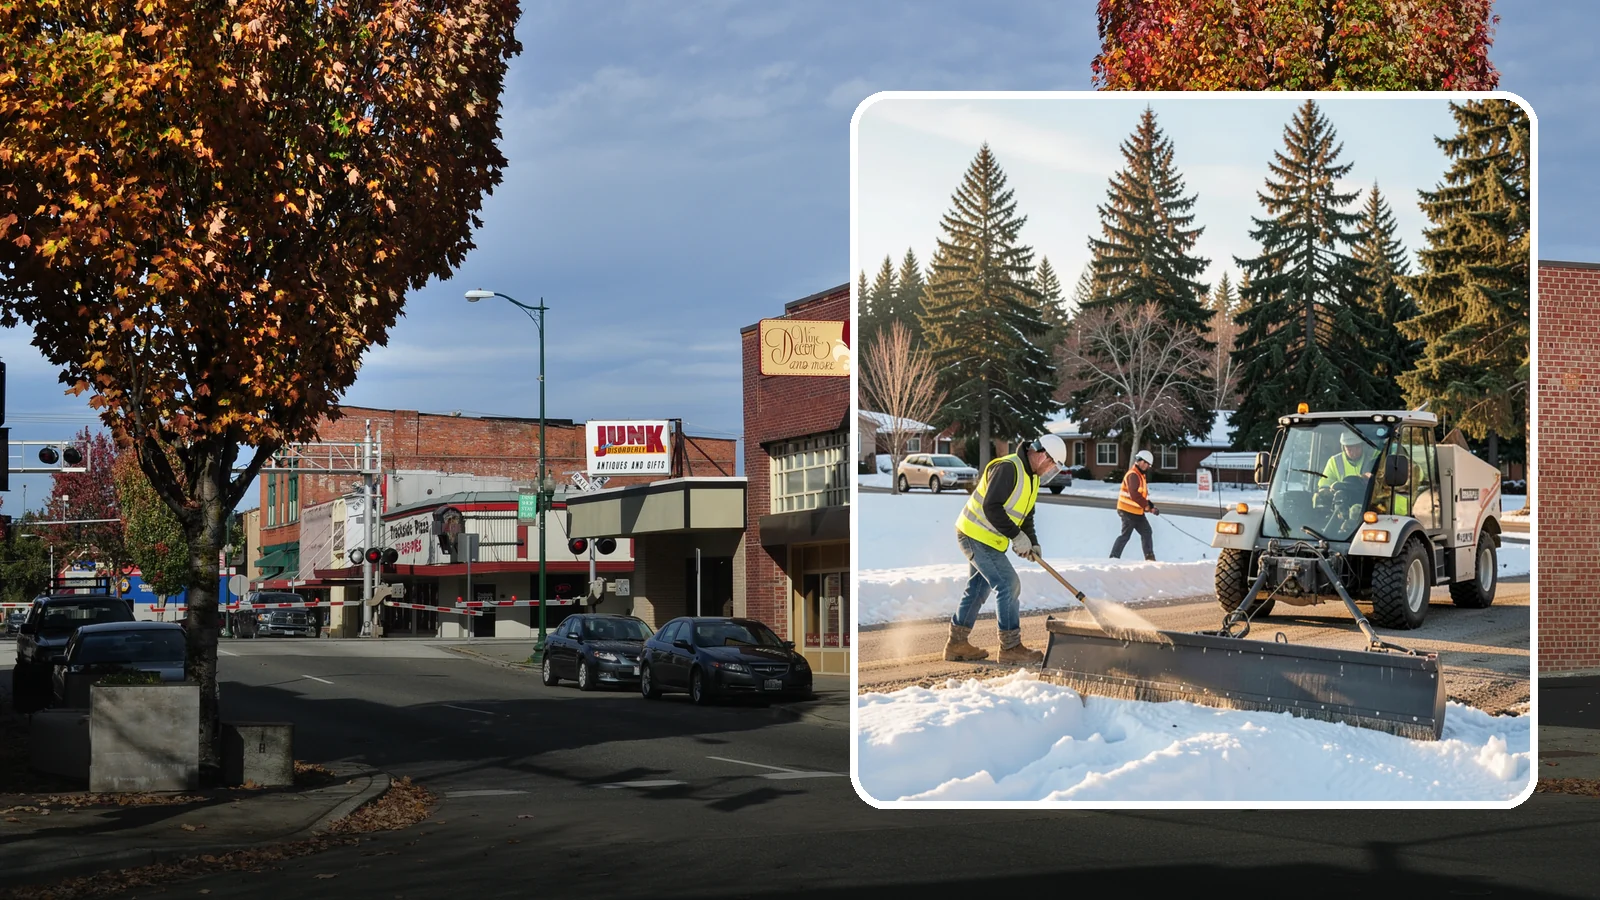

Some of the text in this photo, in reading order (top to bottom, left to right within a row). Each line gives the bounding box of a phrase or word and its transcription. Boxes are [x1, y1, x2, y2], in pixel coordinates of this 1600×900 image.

[596, 425, 666, 457] JUNK
[607, 446, 646, 454] DISORDERLY
[597, 460, 665, 469] ANTIQUES AND GIFTS
[415, 519, 429, 535] Pizza
